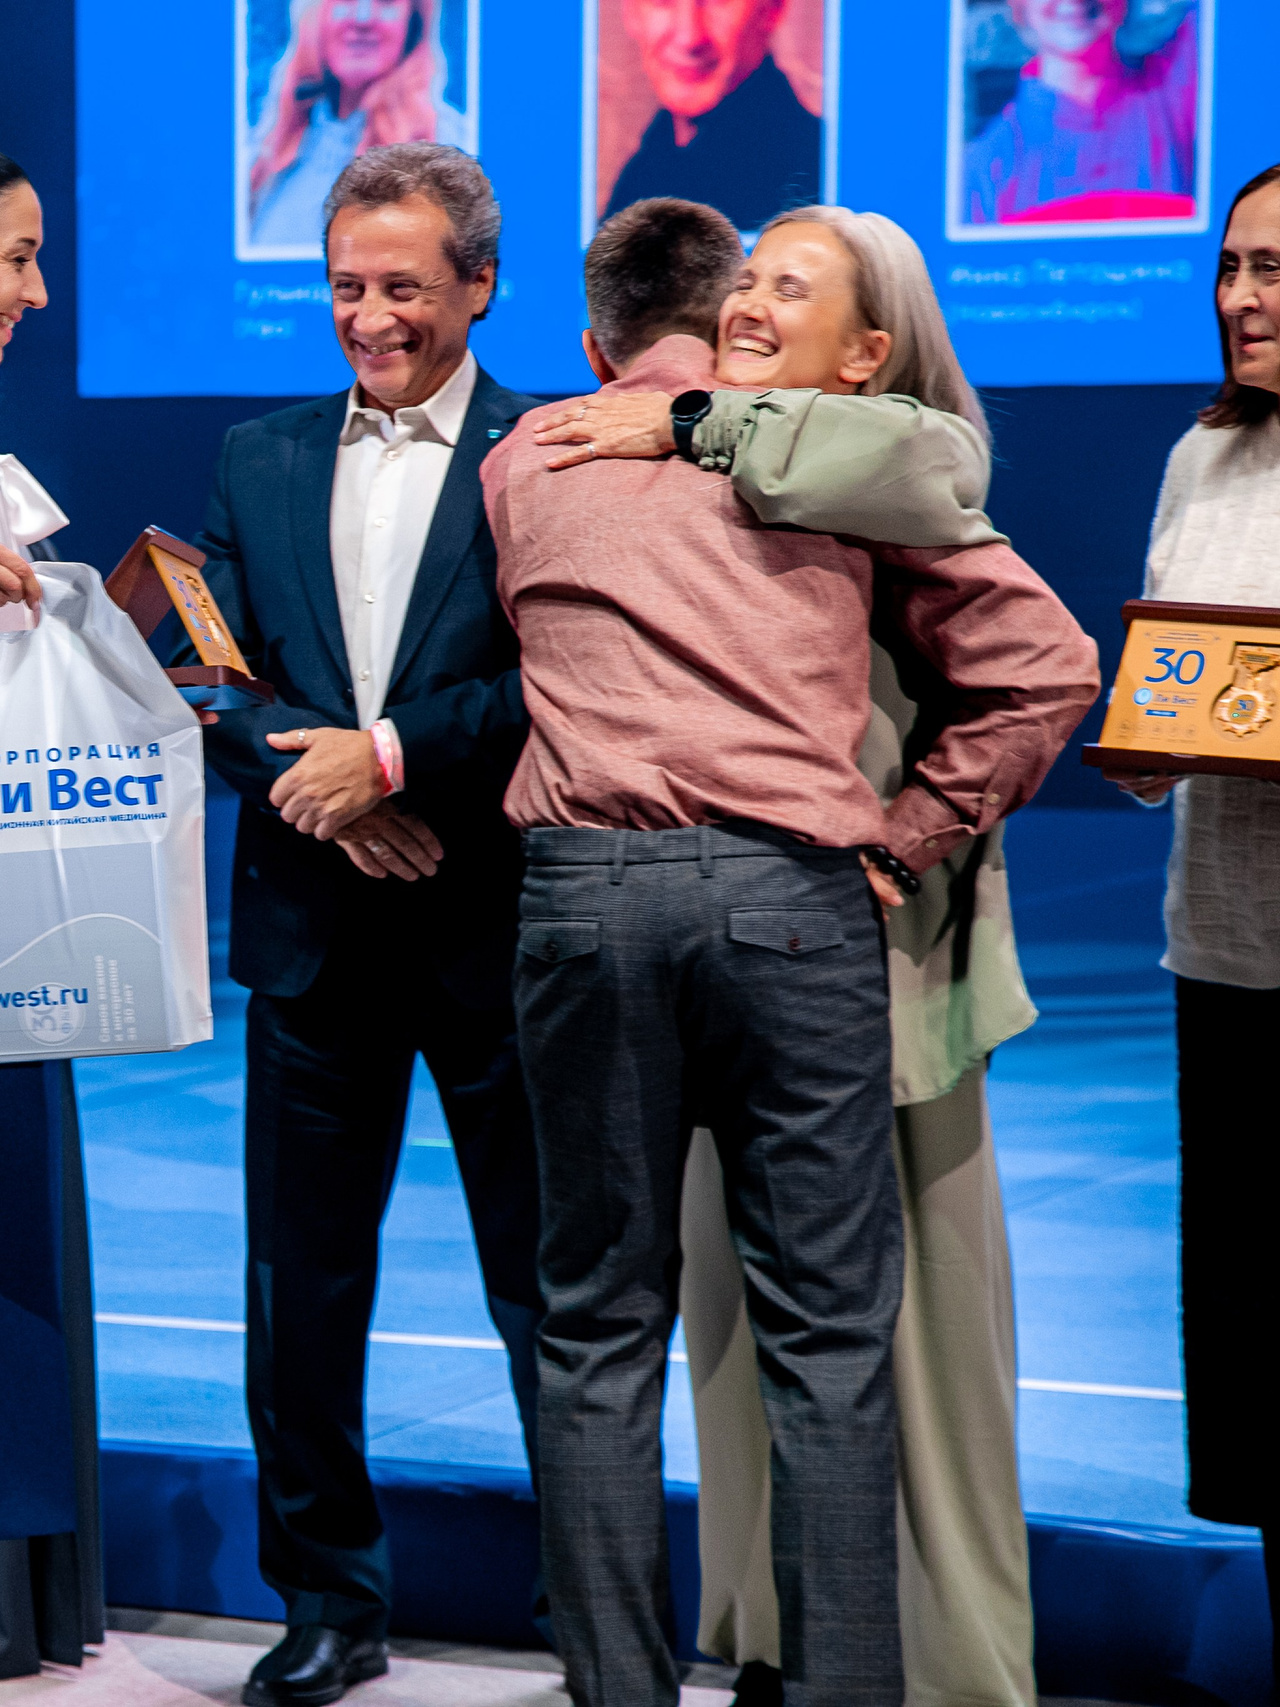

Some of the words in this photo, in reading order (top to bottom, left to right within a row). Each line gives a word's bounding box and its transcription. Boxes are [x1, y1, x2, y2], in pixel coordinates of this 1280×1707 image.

[1144, 647, 1205, 685] 30
[48, 768, 164, 811] Вест
[108, 811, 168, 822] МЕДИЦИНА
